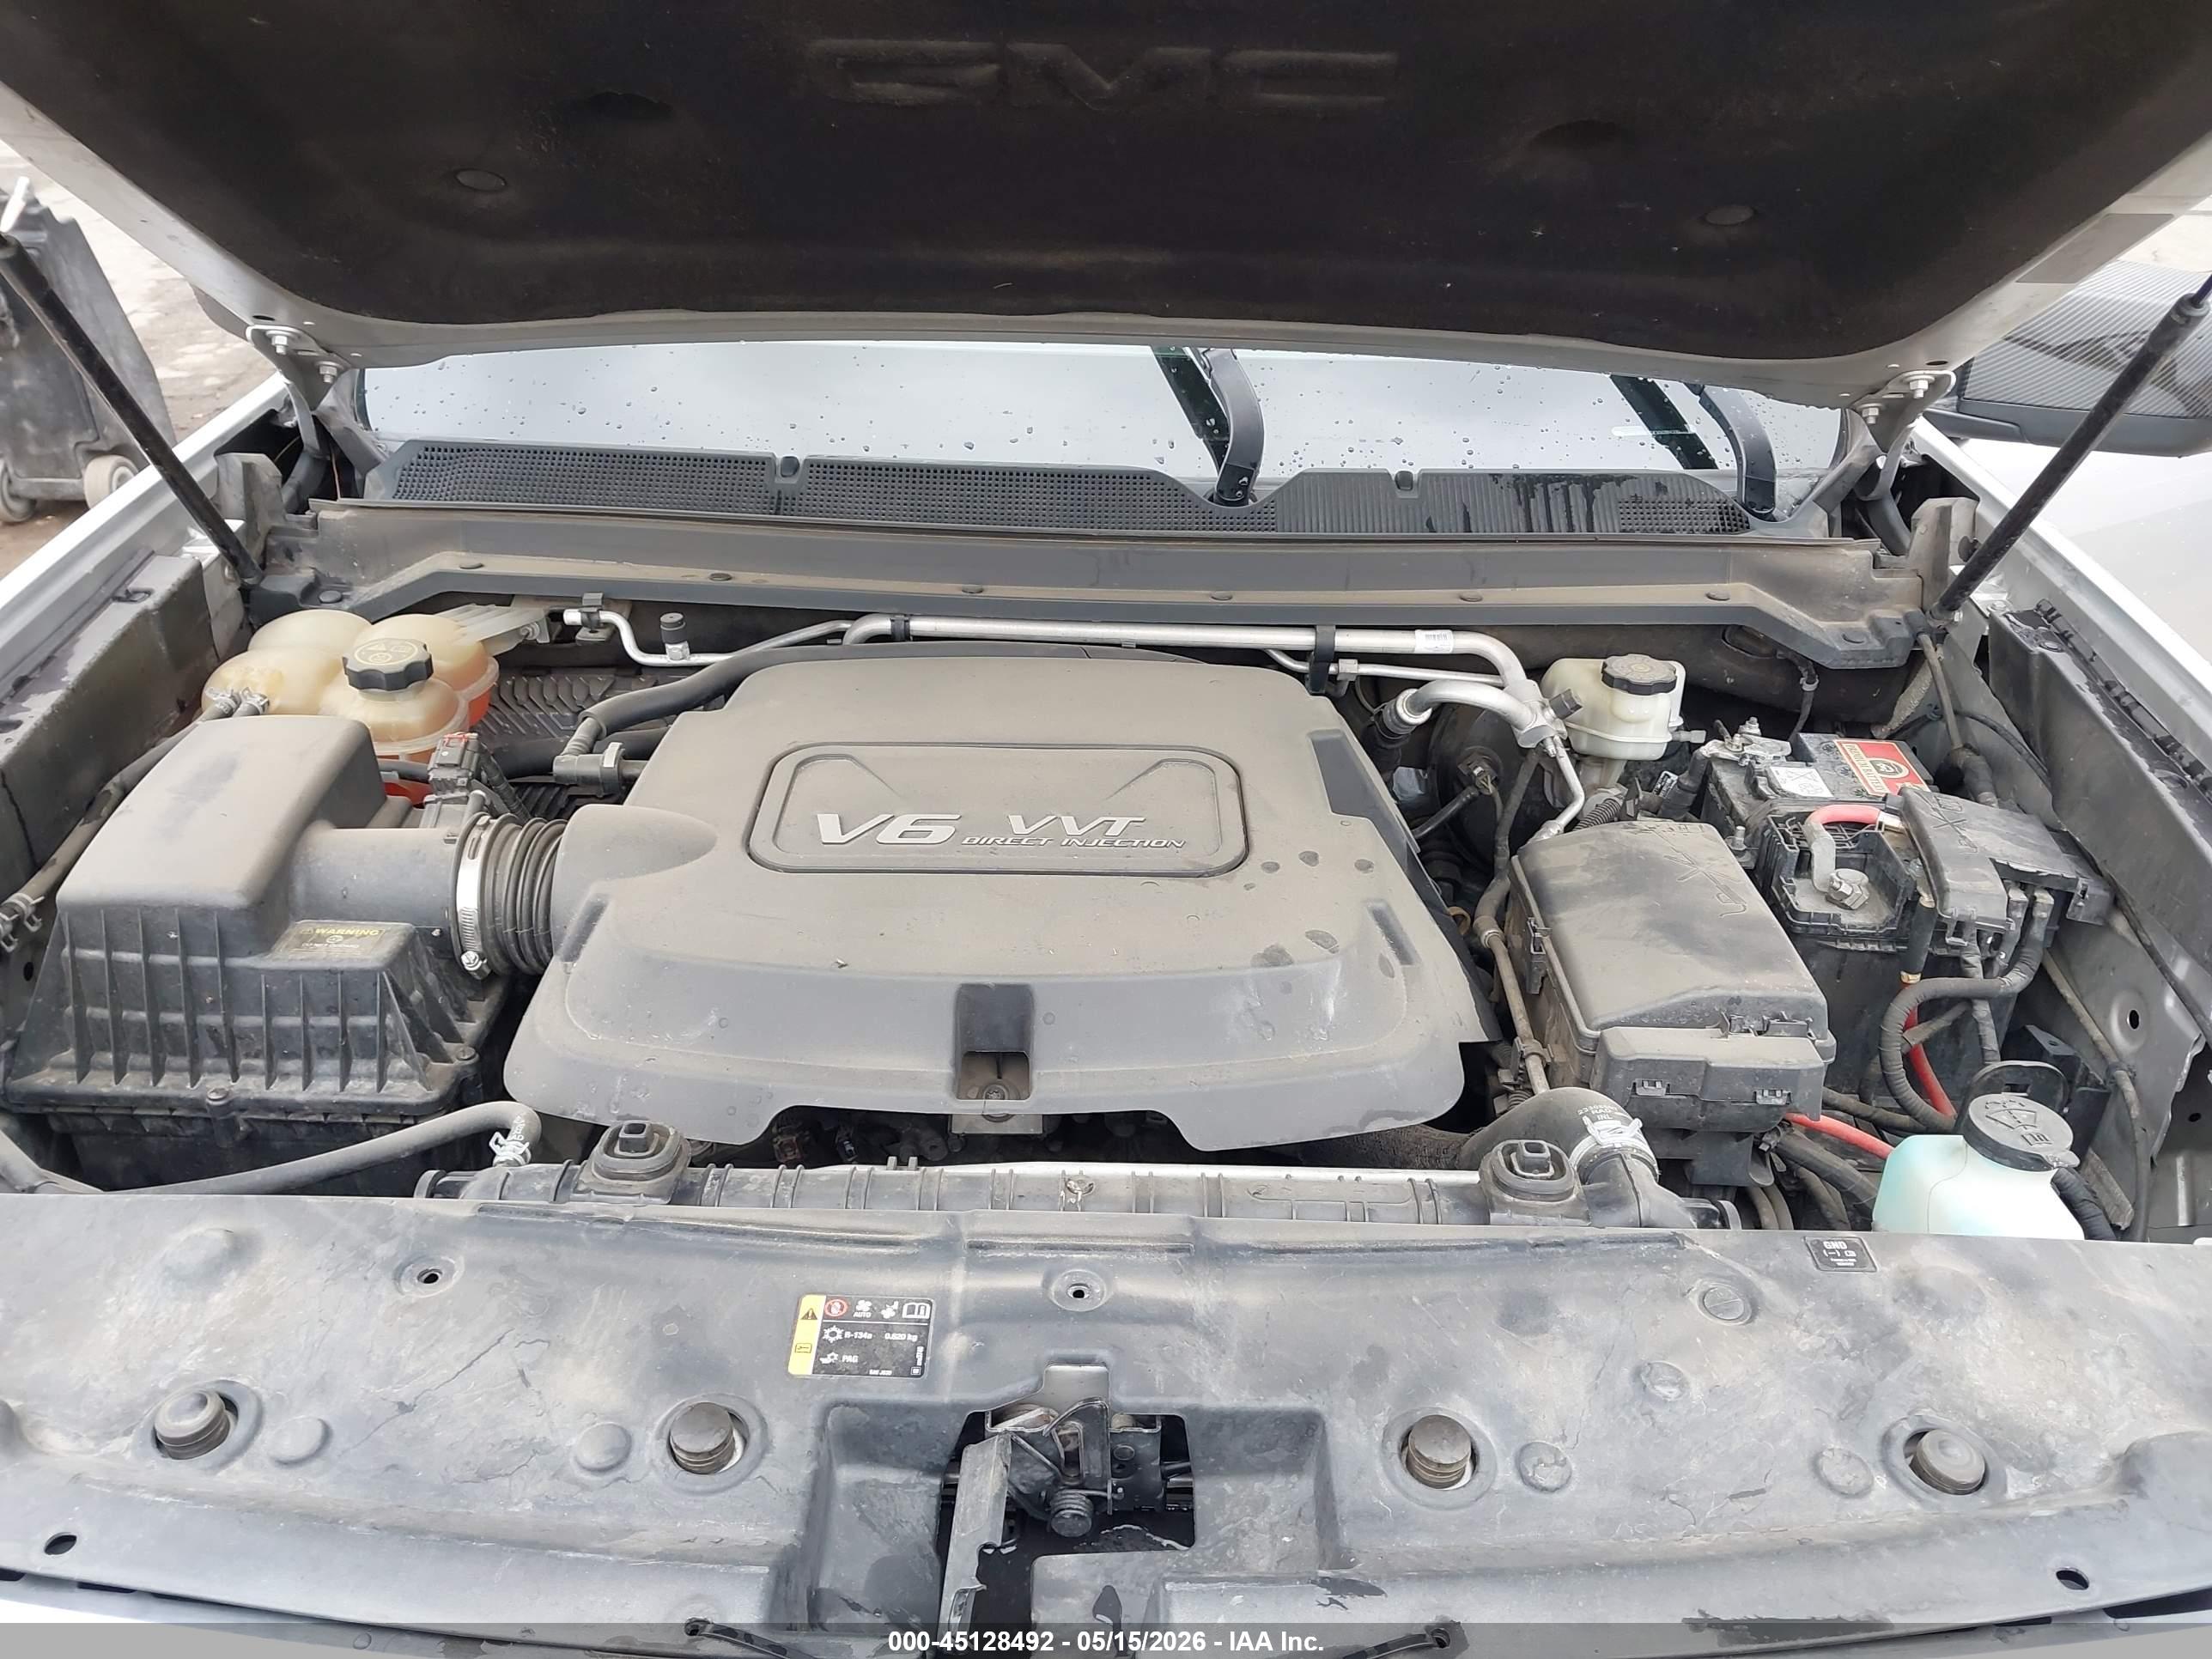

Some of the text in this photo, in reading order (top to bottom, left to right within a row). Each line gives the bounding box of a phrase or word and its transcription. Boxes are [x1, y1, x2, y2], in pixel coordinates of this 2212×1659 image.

[817, 813, 1146, 845] V6 VVT
[961, 836, 1186, 848] DIRECT INJECTION
[1823, 1241, 1847, 1249] GND
